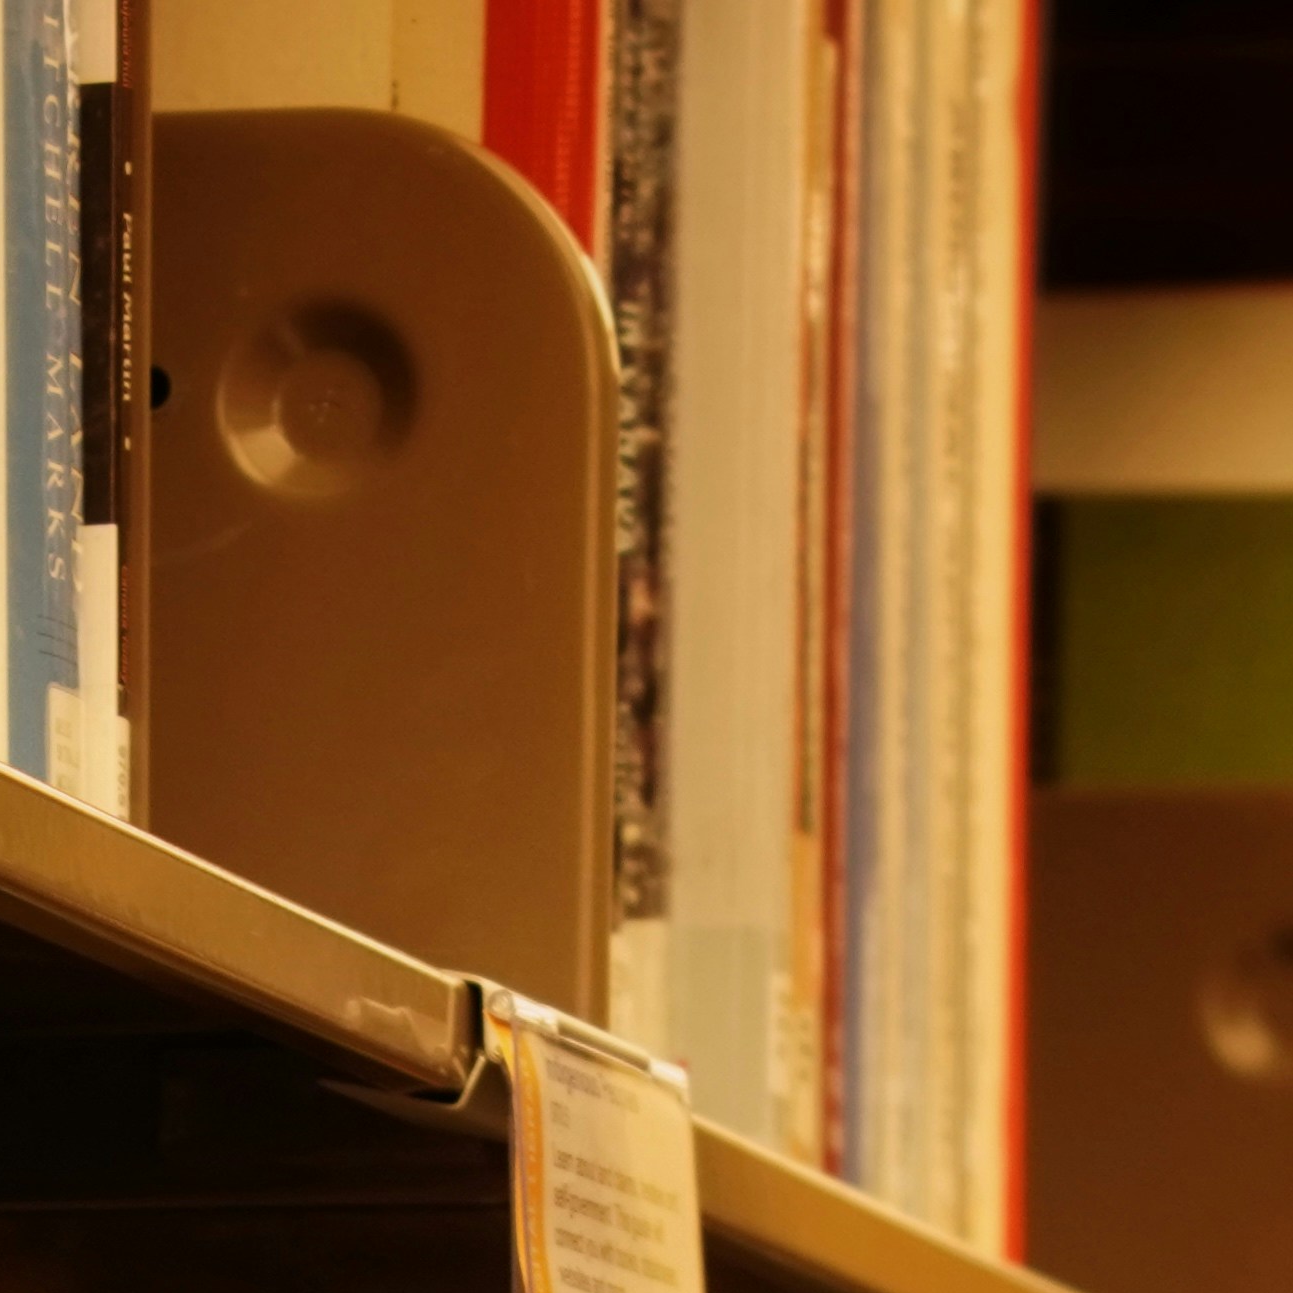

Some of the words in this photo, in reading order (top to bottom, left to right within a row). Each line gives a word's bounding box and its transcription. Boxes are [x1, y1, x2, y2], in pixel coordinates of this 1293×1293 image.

[122, 212, 133, 284] Paul
[122, 291, 133, 402] Martin
[45, 352, 66, 583] MARKS
